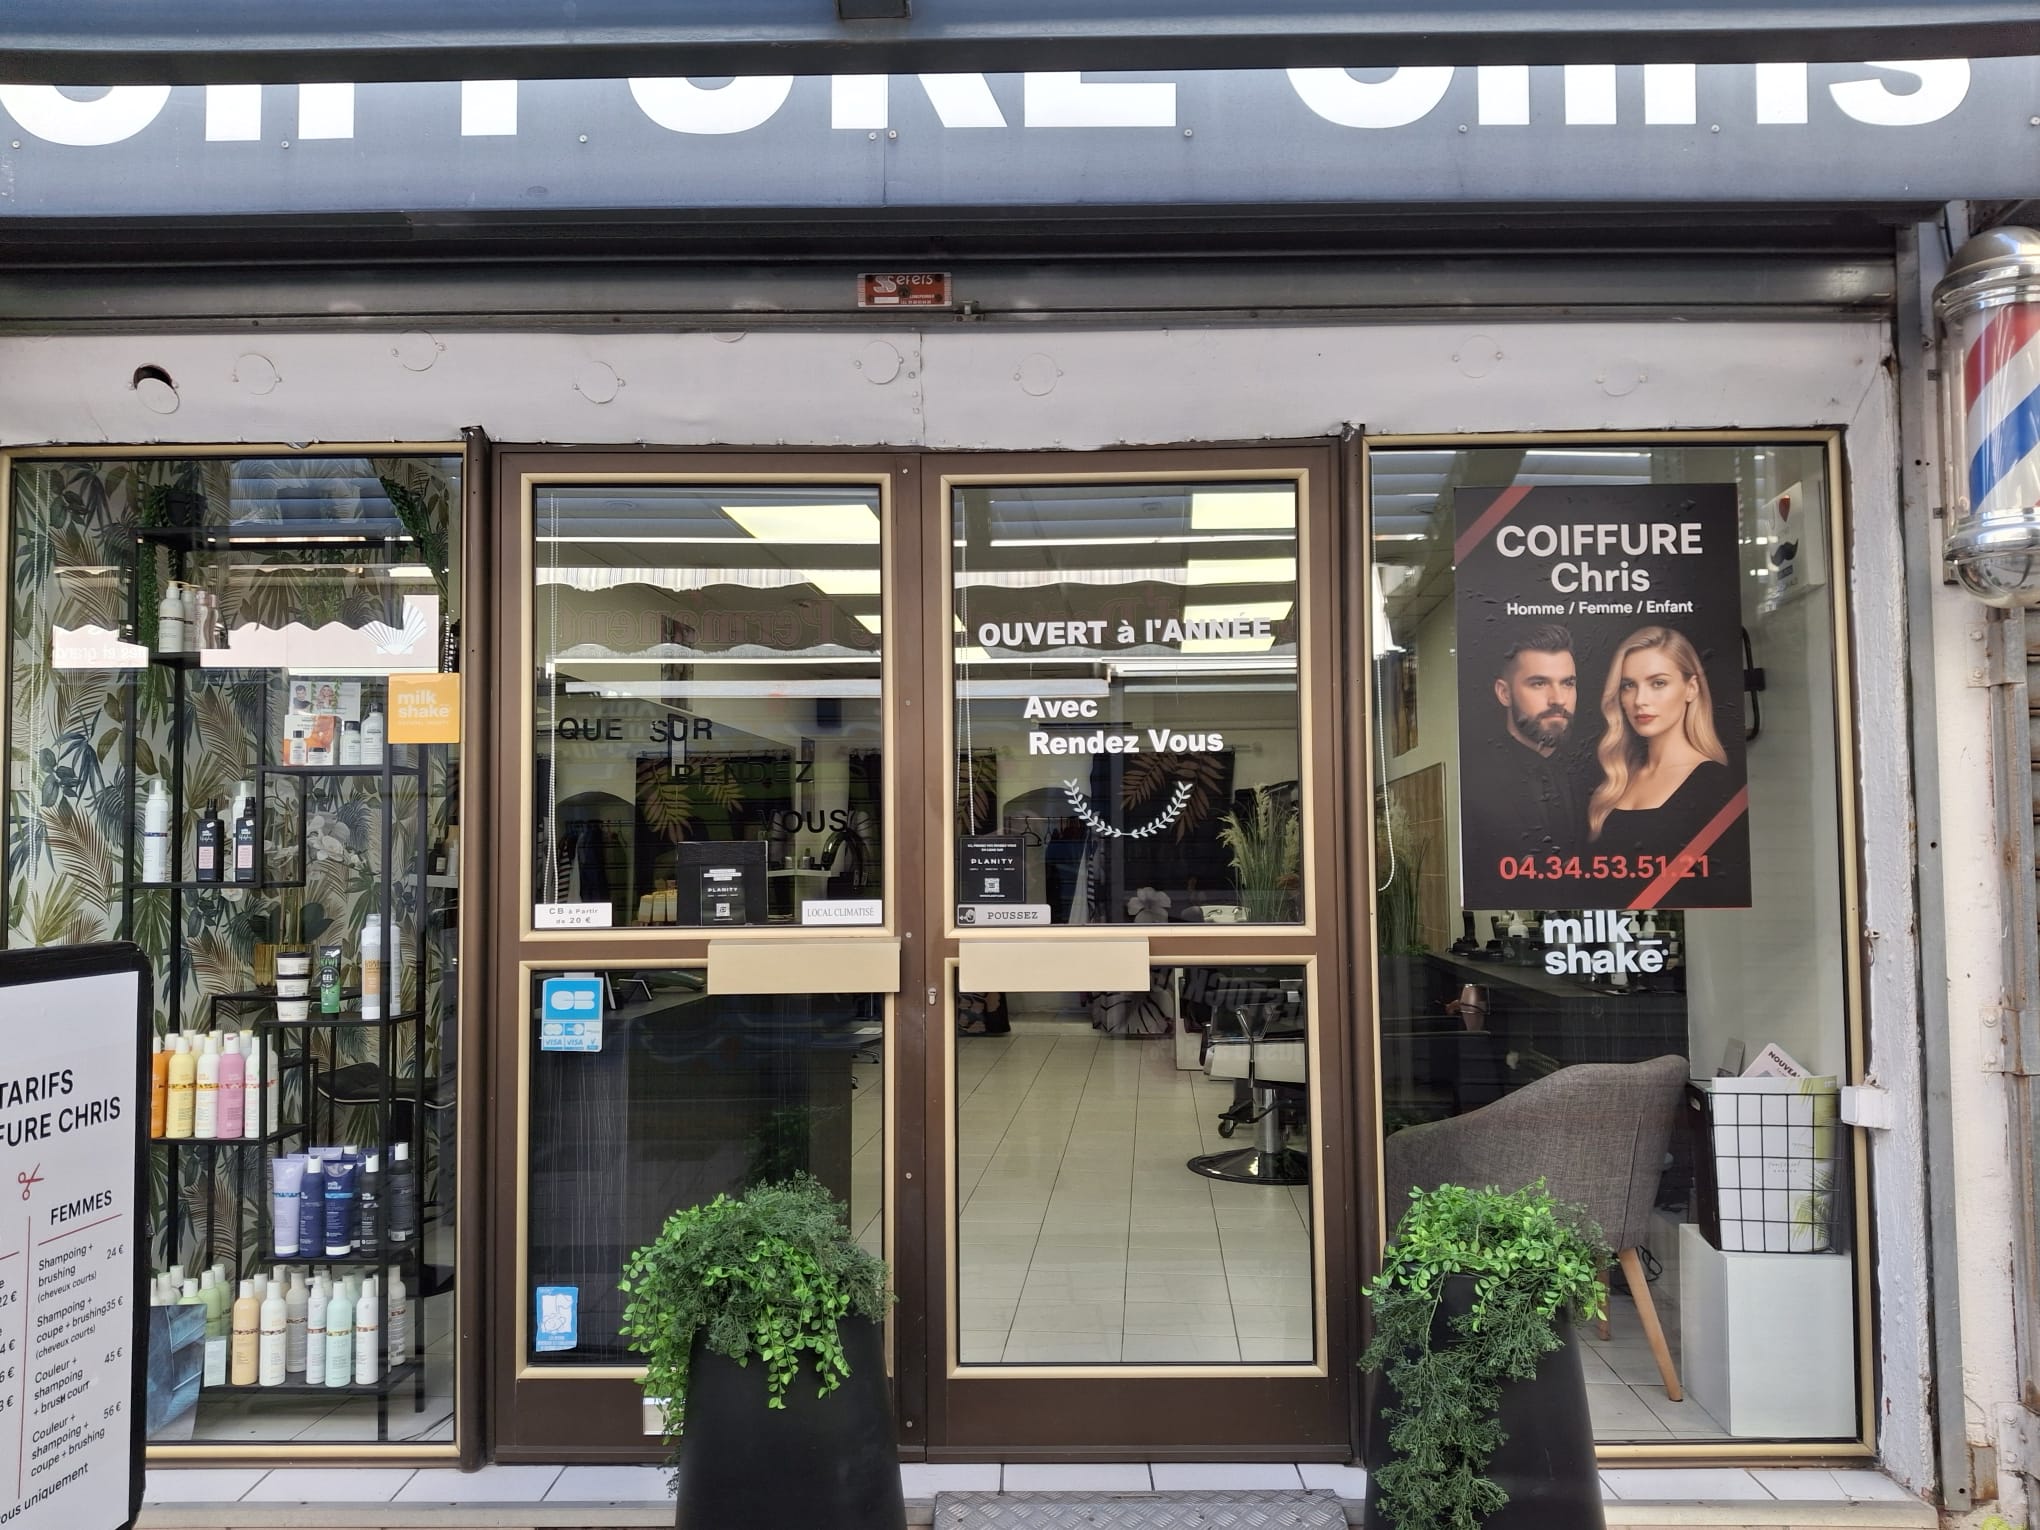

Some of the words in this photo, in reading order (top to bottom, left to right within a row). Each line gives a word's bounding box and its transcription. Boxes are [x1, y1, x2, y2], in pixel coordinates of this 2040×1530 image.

[1496, 523, 1703, 558] COIFFURE
[1550, 562, 1651, 593] Chris
[1506, 602, 1565, 616] Homme
[1568, 601, 1575, 615] /
[1578, 601, 1633, 614] Femme
[1637, 600, 1643, 614] /
[1646, 600, 1694, 614] Enfant
[978, 621, 1107, 647] OUVERT
[1117, 619, 1135, 643] à
[1145, 611, 1271, 643] l'ANNÉE
[1023, 696, 1098, 719] Avec
[558, 717, 623, 742] QUE
[649, 716, 713, 743] SUR
[1029, 731, 1140, 755] Rendez
[1147, 729, 1224, 752] Vous
[675, 760, 814, 785] RENDEZ
[758, 809, 849, 834] VOUS
[1498, 855, 1711, 881] 04.34.53.51.21
[549, 907, 564, 915] CB
[807, 908, 832, 917] LOCAL
[987, 911, 1039, 920] POUSSEZ
[1543, 942, 1664, 975] shake
[0, 1069, 73, 1109] TARIFS
[58, 1096, 121, 1133] CHRIS
[51, 1190, 113, 1226] FEMMES
[39, 1245, 87, 1271] Shampoing
[106, 1247, 117, 1260] 24
[118, 1244, 124, 1255] €
[37, 1282, 71, 1303] (cheveux
[72, 1270, 97, 1287] courts)
[38, 1265, 76, 1287] brushing
[11, 1291, 17, 1302] €
[37, 1300, 86, 1327] Shampoing
[9, 1339, 16, 1351] €
[36, 1324, 64, 1344] coupe
[36, 1338, 70, 1360] (cheveux
[70, 1324, 96, 1343] courts)
[104, 1351, 115, 1363] 45
[116, 1347, 123, 1357] €
[8, 1366, 15, 1379] €
[34, 1360, 70, 1383] Couleur
[34, 1370, 83, 1400] shampoing
[7, 1395, 14, 1407] €
[103, 1405, 114, 1419] 56
[115, 1401, 121, 1412] €
[31, 1425, 82, 1460] shampoing
[32, 1417, 68, 1443] Couleur
[31, 1454, 60, 1477] coupe
[68, 1428, 105, 1455] brushing
[24, 1463, 88, 1510] uniquement
